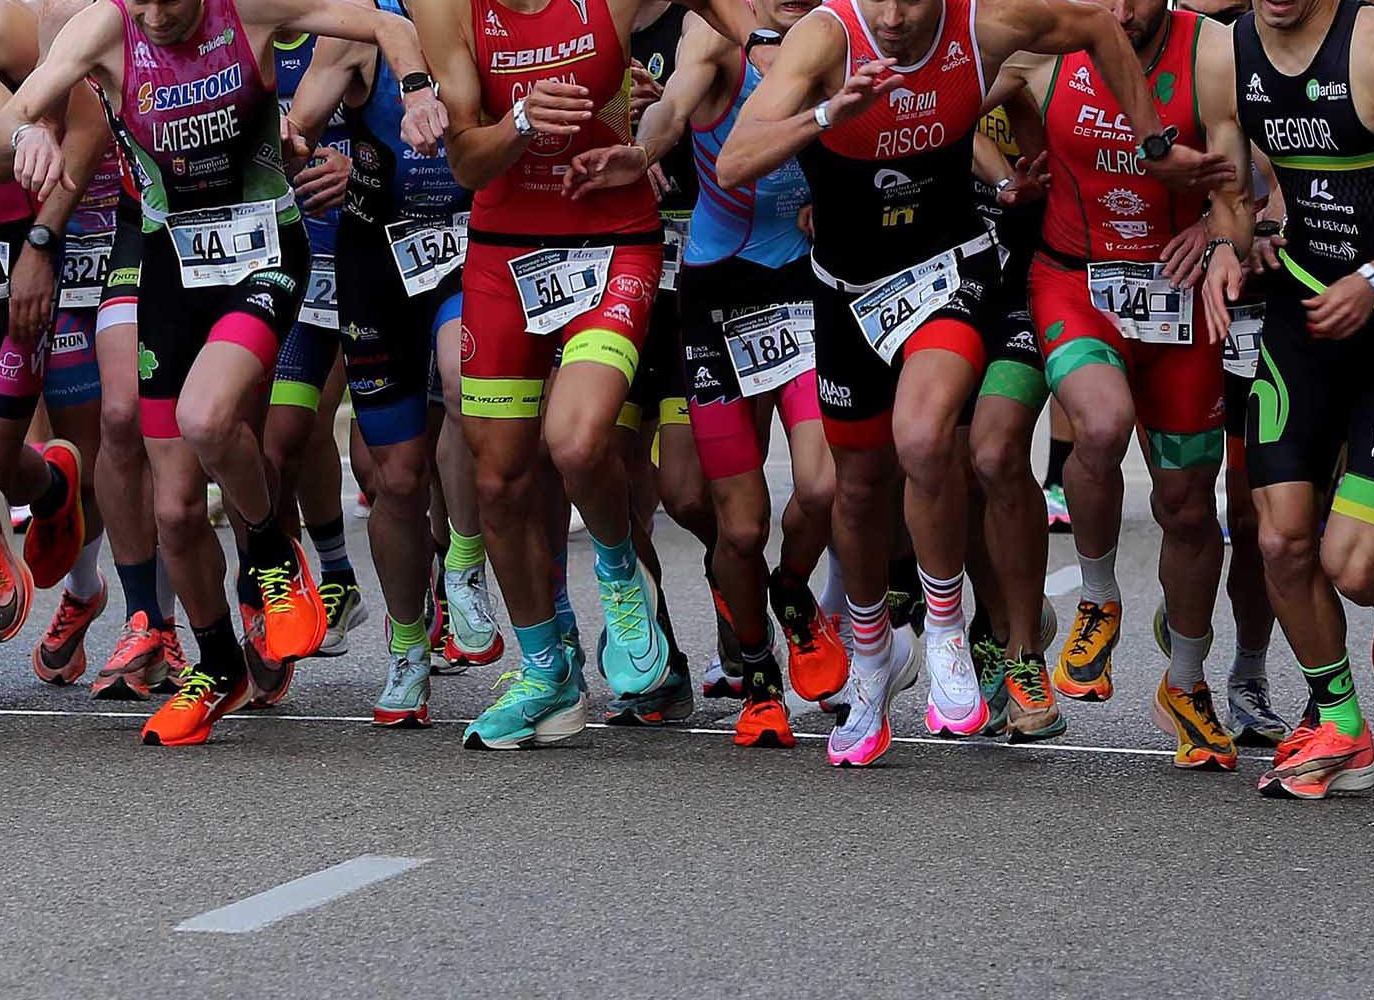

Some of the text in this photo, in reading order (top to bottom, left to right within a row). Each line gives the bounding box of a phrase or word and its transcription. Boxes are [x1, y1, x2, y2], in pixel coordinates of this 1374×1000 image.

[491, 33, 595, 67] ISBILYA
[155, 63, 243, 112] SALTOKI
[152, 104, 241, 153] LATESTERE
[875, 122, 945, 159] RISCO
[1264, 117, 1339, 151] REGIDOR
[192, 230, 227, 260] 4A
[405, 231, 460, 271] 15A
[535, 272, 566, 307] 5A
[1100, 285, 1150, 321] 12A
[879, 296, 915, 331] 6A
[741, 327, 801, 369] 18A
